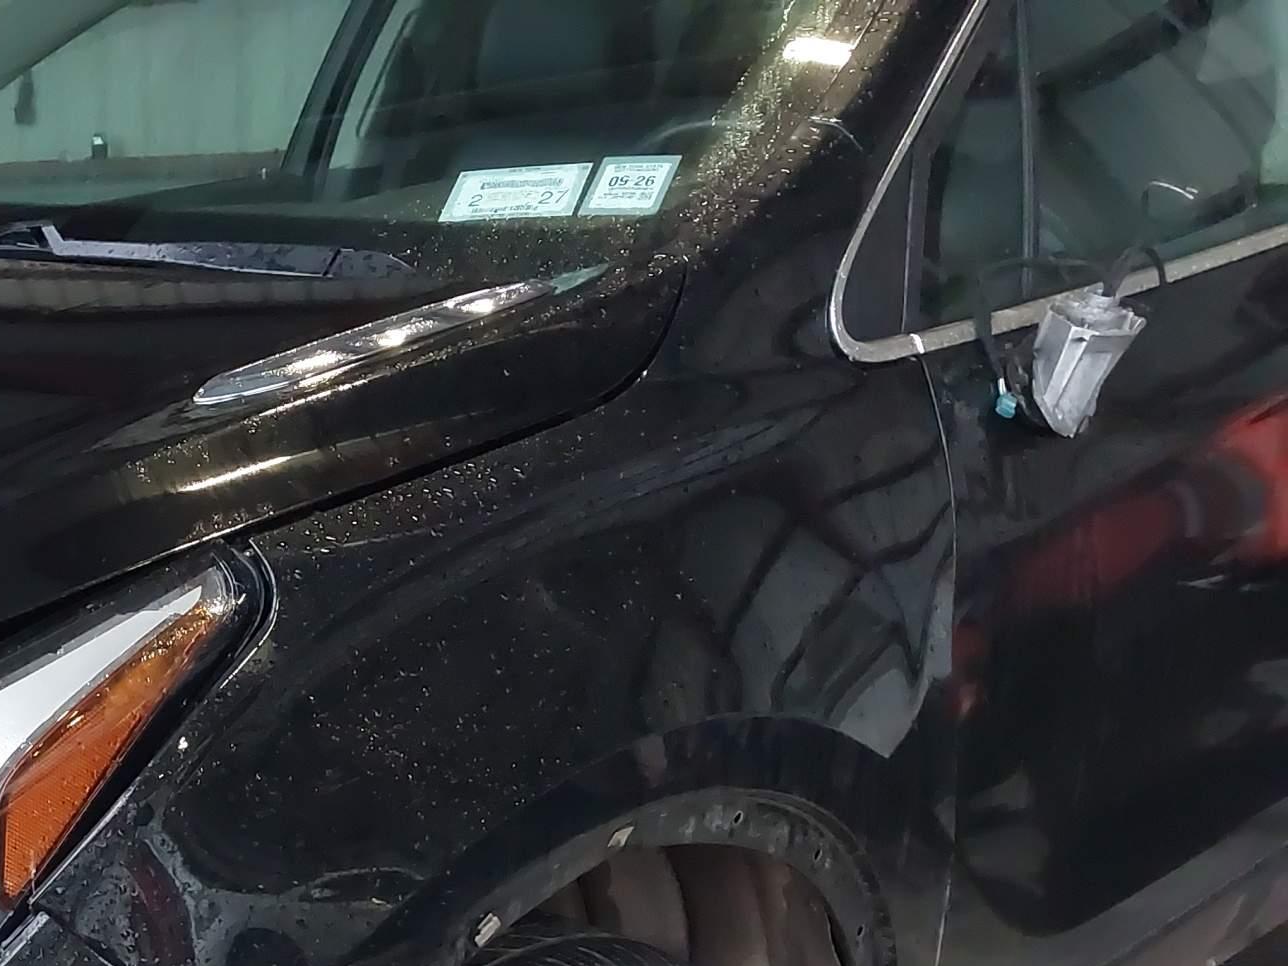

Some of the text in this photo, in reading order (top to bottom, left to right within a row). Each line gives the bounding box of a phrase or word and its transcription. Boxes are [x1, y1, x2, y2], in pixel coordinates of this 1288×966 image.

[633, 175, 657, 187] 26
[468, 194, 484, 208] 2
[537, 188, 569, 205] 27
